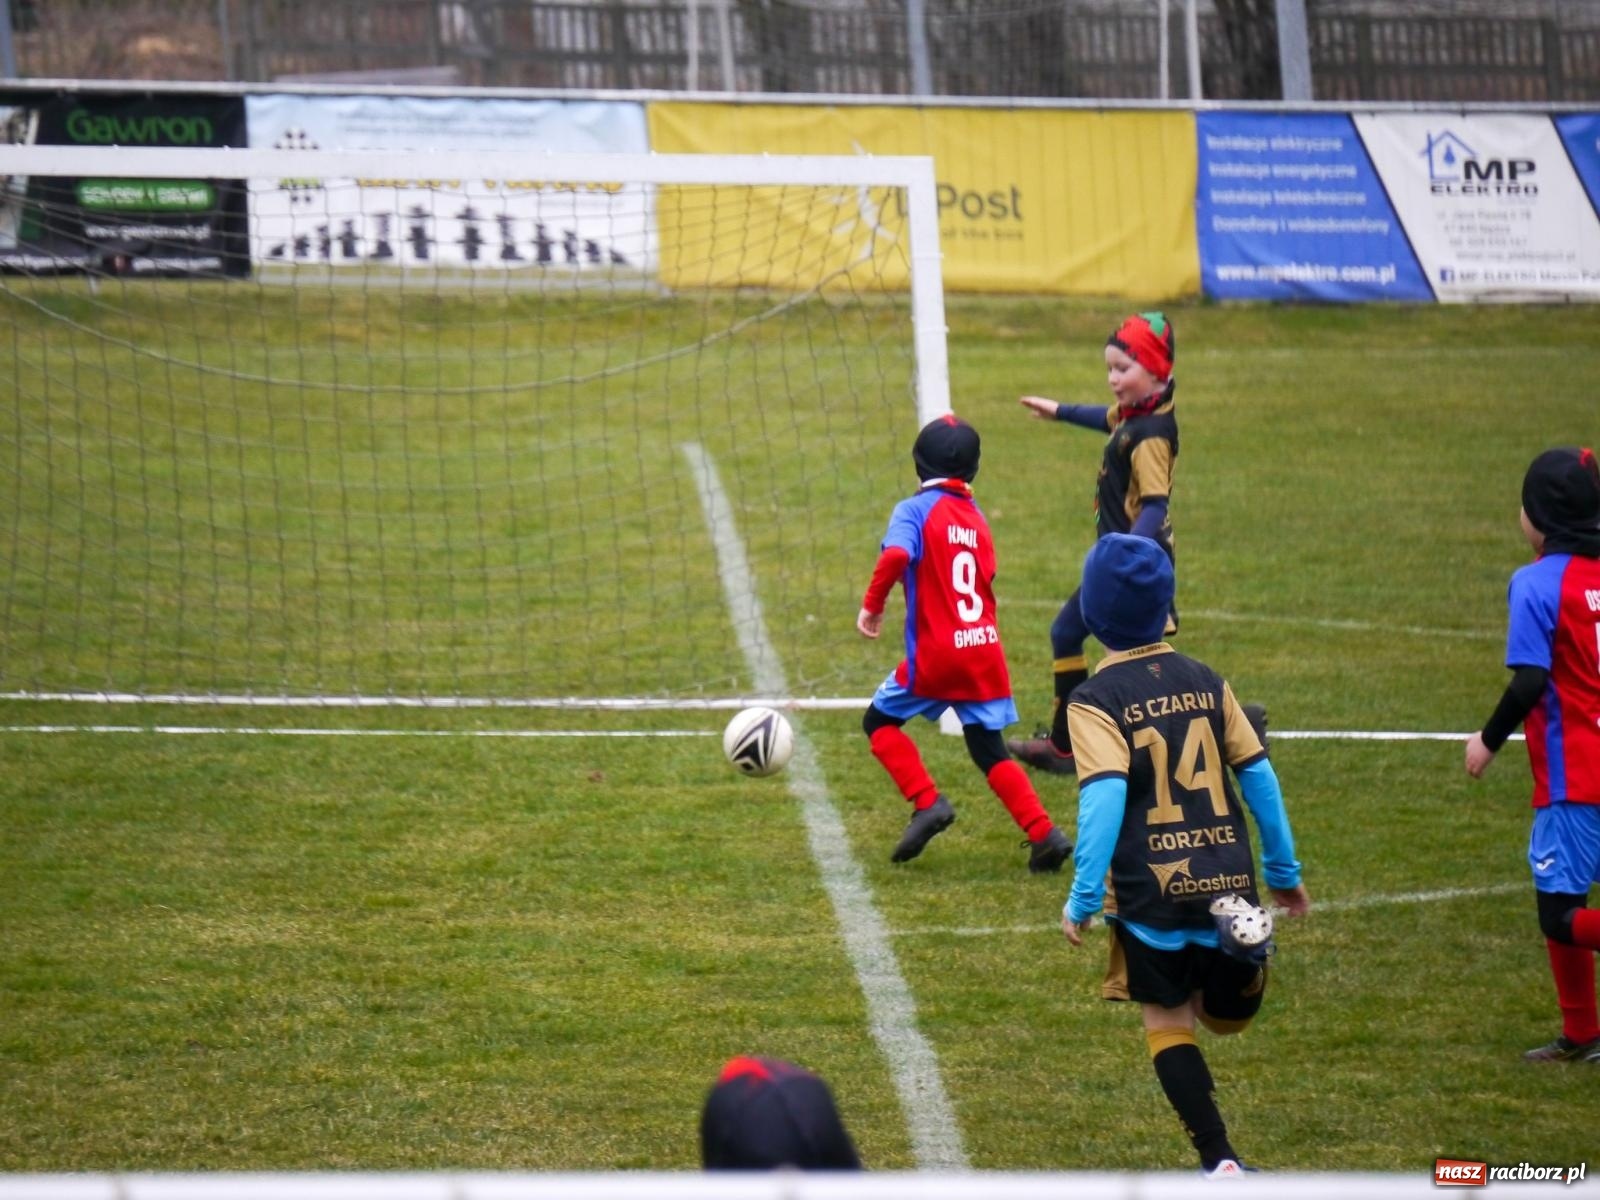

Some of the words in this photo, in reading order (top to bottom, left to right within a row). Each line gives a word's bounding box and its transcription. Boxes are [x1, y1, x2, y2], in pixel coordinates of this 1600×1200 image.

[66, 109, 213, 143] Gawron
[1464, 160, 1536, 180] MP
[1431, 184, 1538, 196] ELEKTRO
[1216, 262, 1396, 286] www.mpelektro.com.pl
[952, 551, 983, 623] 9
[1132, 716, 1229, 825] 14
[1148, 826, 1236, 851] GORZYCE
[1169, 873, 1250, 895] abastran
